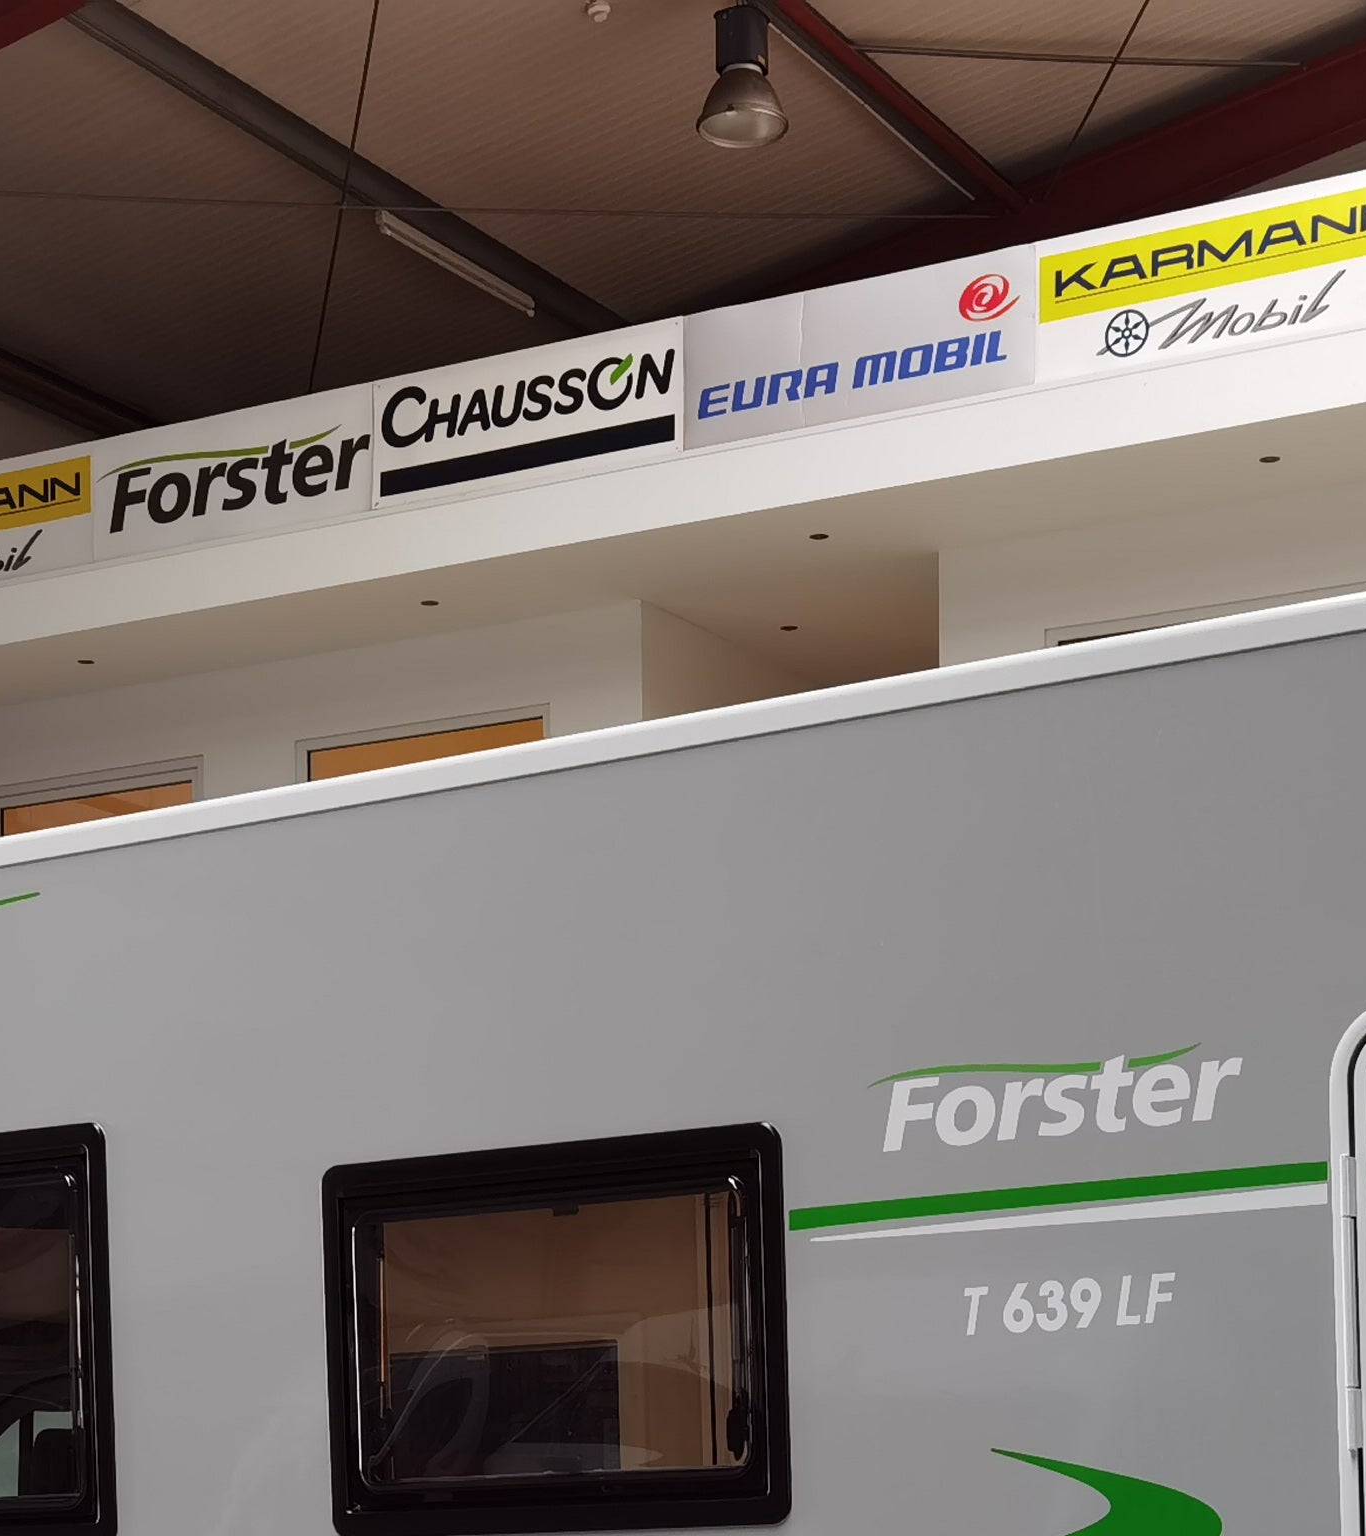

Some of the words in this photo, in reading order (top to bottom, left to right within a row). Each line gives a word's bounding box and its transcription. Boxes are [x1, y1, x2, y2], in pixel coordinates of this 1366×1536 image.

[1148, 269, 1347, 350] Mobil
[381, 348, 675, 448] CHAUSSON
[697, 361, 839, 420] EURA
[852, 330, 1008, 389] MOBIL
[109, 432, 371, 533] Forster
[882, 1053, 1244, 1153] Forster
[963, 1286, 989, 1336] T
[1002, 1277, 1102, 1333] 639
[1116, 1271, 1176, 1326] LF
